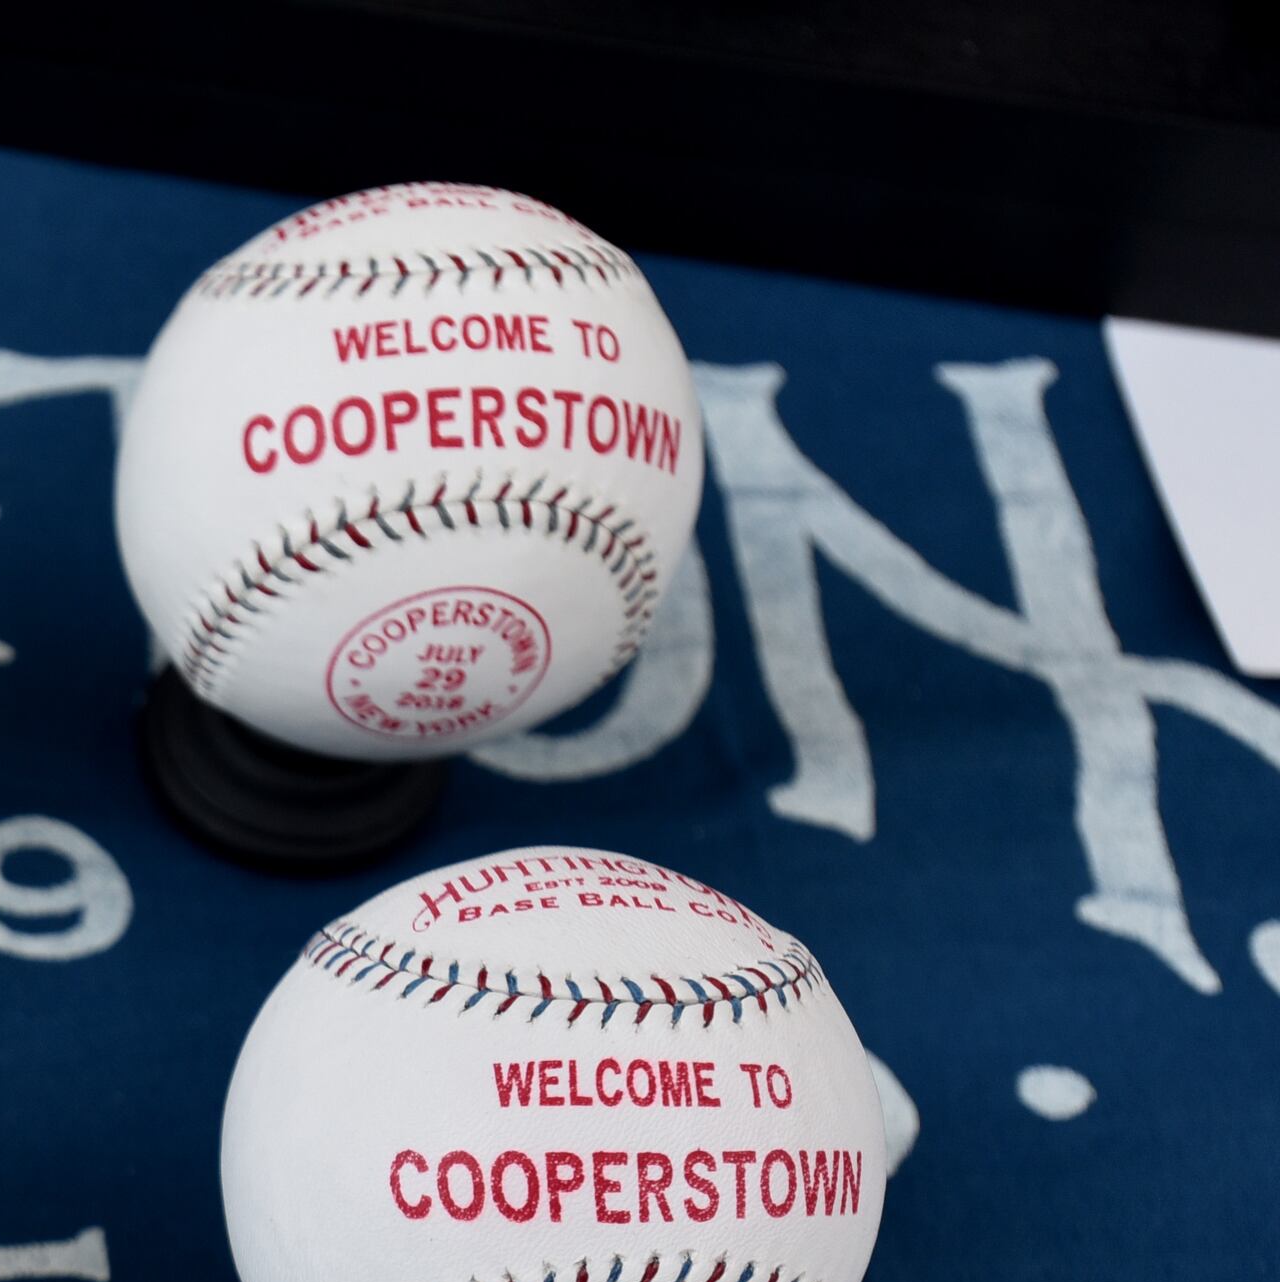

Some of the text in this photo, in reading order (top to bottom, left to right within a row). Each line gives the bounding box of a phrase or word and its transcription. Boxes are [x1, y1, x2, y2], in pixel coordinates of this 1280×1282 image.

[333, 313, 621, 364] WELCOME TO
[242, 387, 682, 476] COOPERSTOWN
[347, 599, 538, 675] COOPERSTOWN
[416, 643, 485, 664] JULY
[414, 666, 467, 692] 29
[457, 892, 750, 928] BASE BALL CO.
[492, 1057, 793, 1110] WELCOME TO
[389, 1147, 862, 1225] COOPERSTOWN
